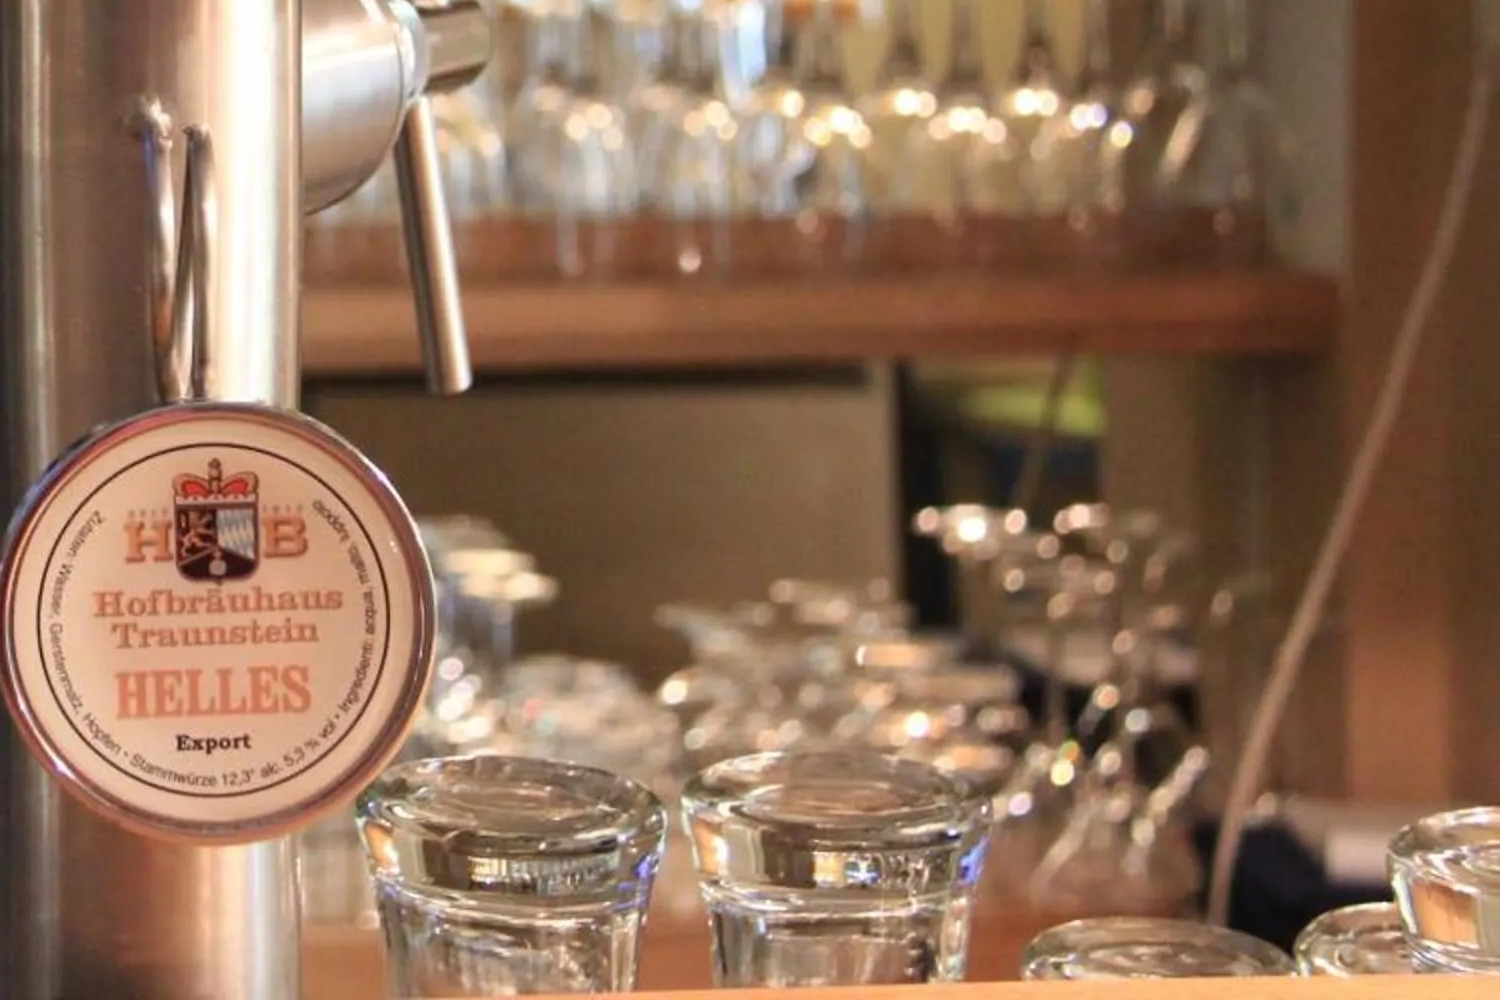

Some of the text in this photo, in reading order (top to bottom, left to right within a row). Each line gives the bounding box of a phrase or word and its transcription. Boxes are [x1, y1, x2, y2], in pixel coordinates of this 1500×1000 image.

[124, 513, 309, 563] H B
[91, 586, 345, 618] Hofbräuhaus
[111, 616, 321, 650] Traunstein
[114, 664, 313, 721] HELLES
[82, 711, 122, 756] Hopfen
[129, 752, 218, 788] Stammwürze
[318, 717, 339, 740] vol
[175, 733, 252, 755] Export
